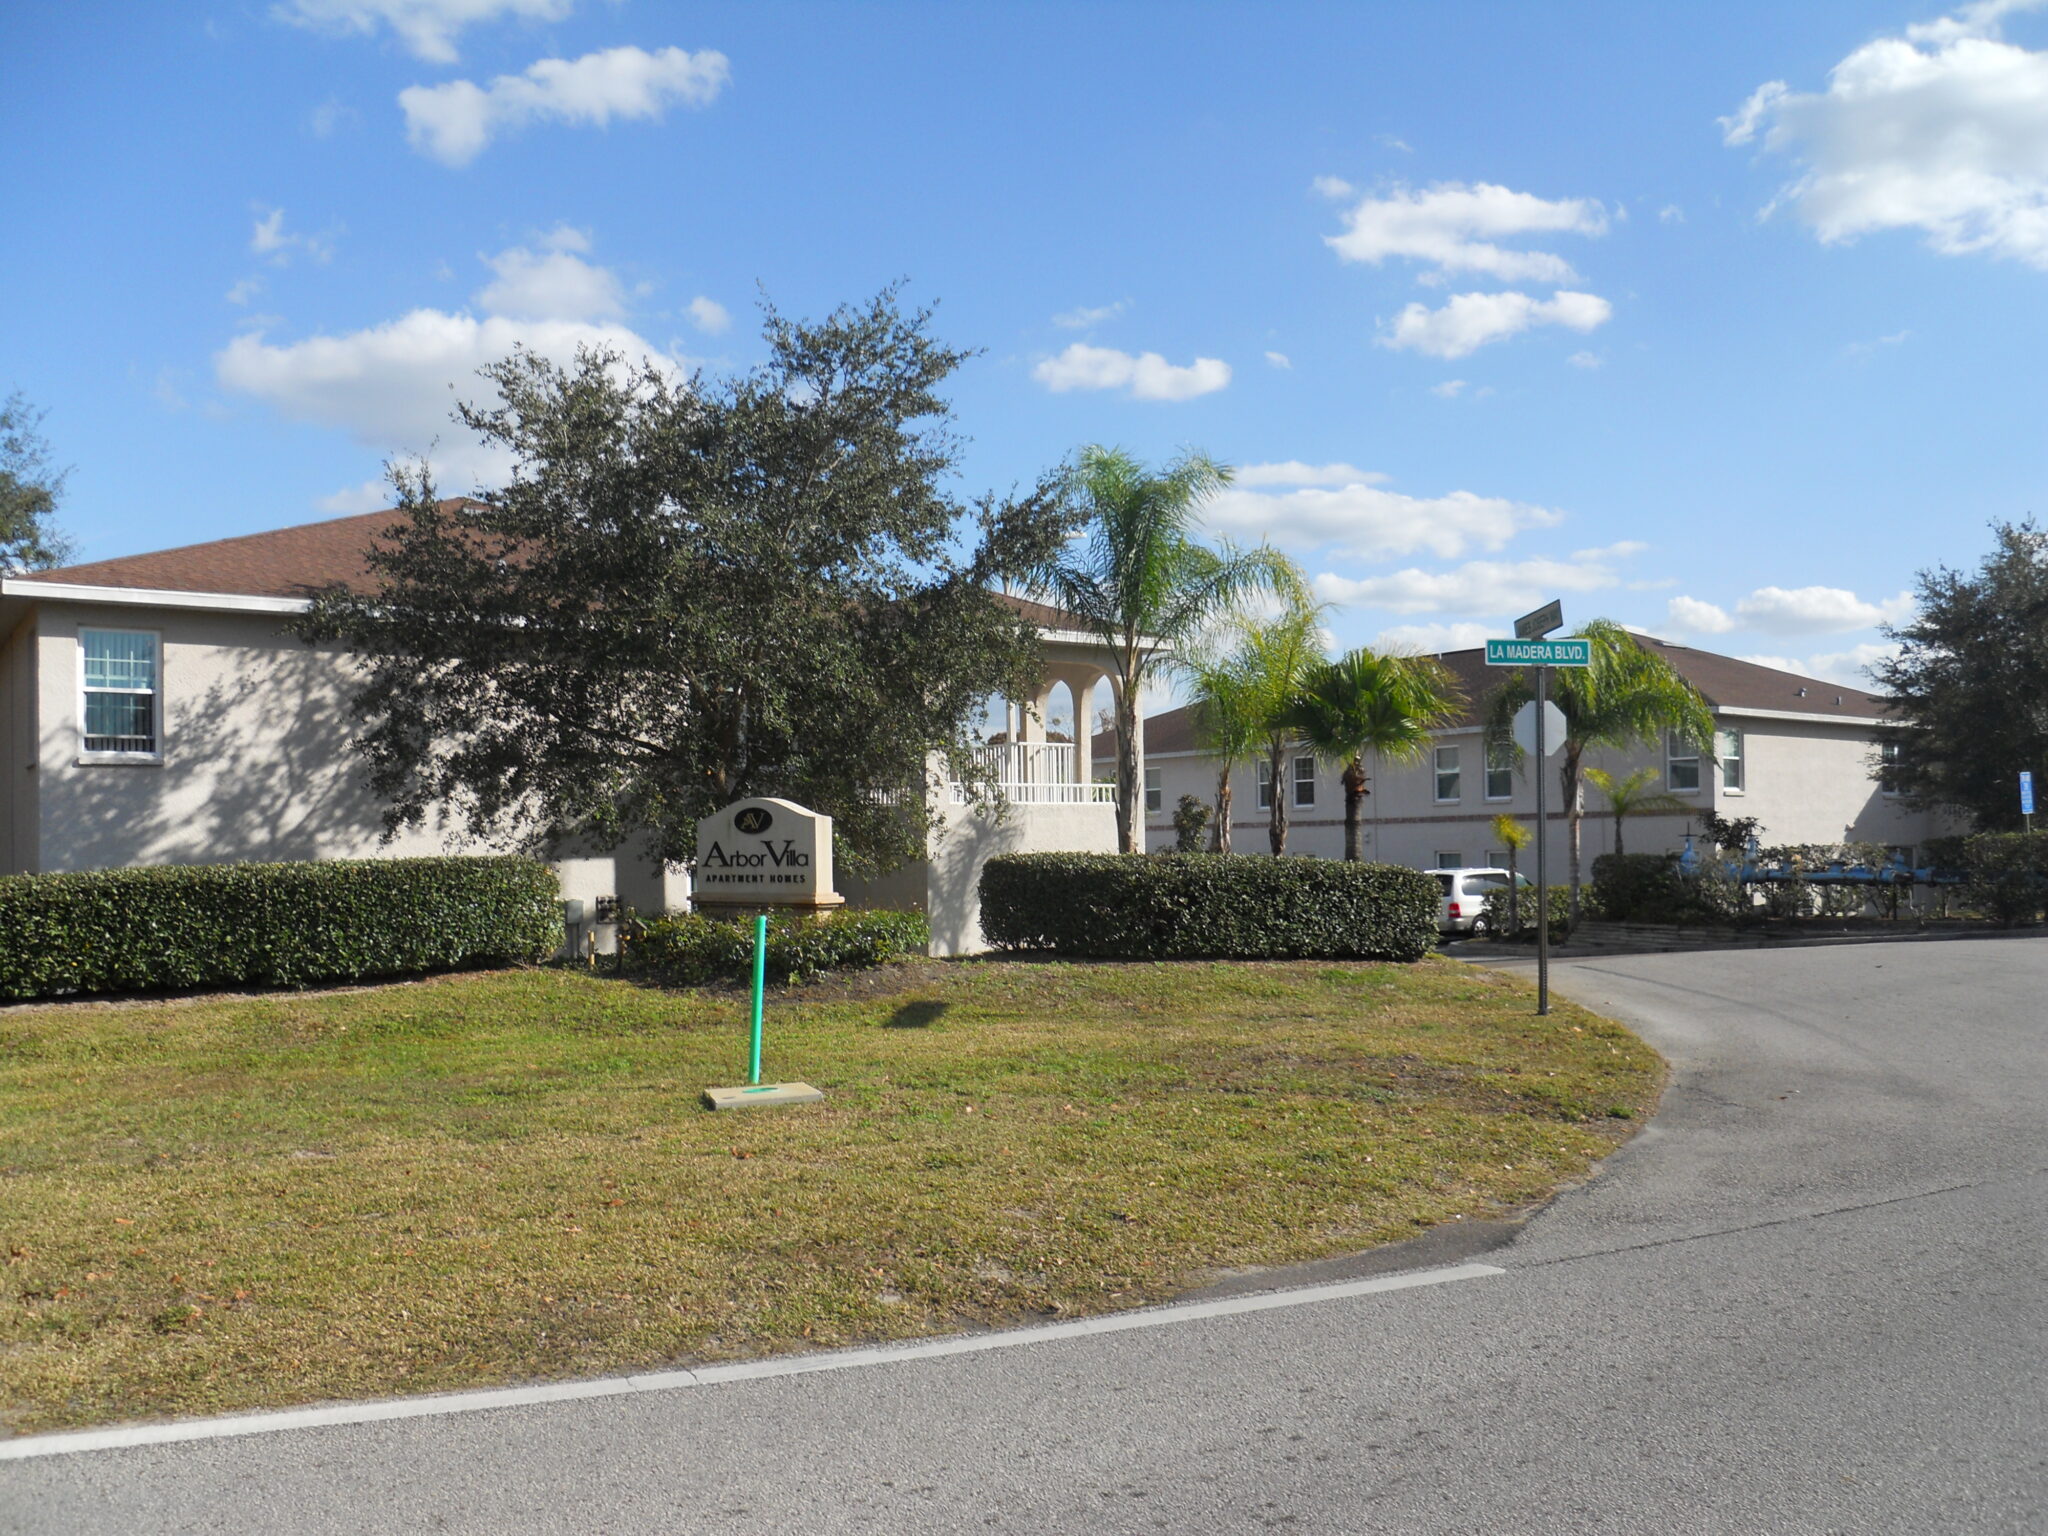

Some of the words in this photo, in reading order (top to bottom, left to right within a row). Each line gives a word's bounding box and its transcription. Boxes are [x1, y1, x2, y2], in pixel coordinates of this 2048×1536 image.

[1489, 644, 1504, 659] LA
[1507, 645, 1552, 660] MADERA
[1554, 645, 1585, 660] BLVD.
[740, 812, 765, 830] AV
[702, 840, 767, 868] Arbor
[760, 840, 809, 867] Villa
[706, 874, 765, 884] APARTMENT
[769, 874, 806, 884] HOMES
